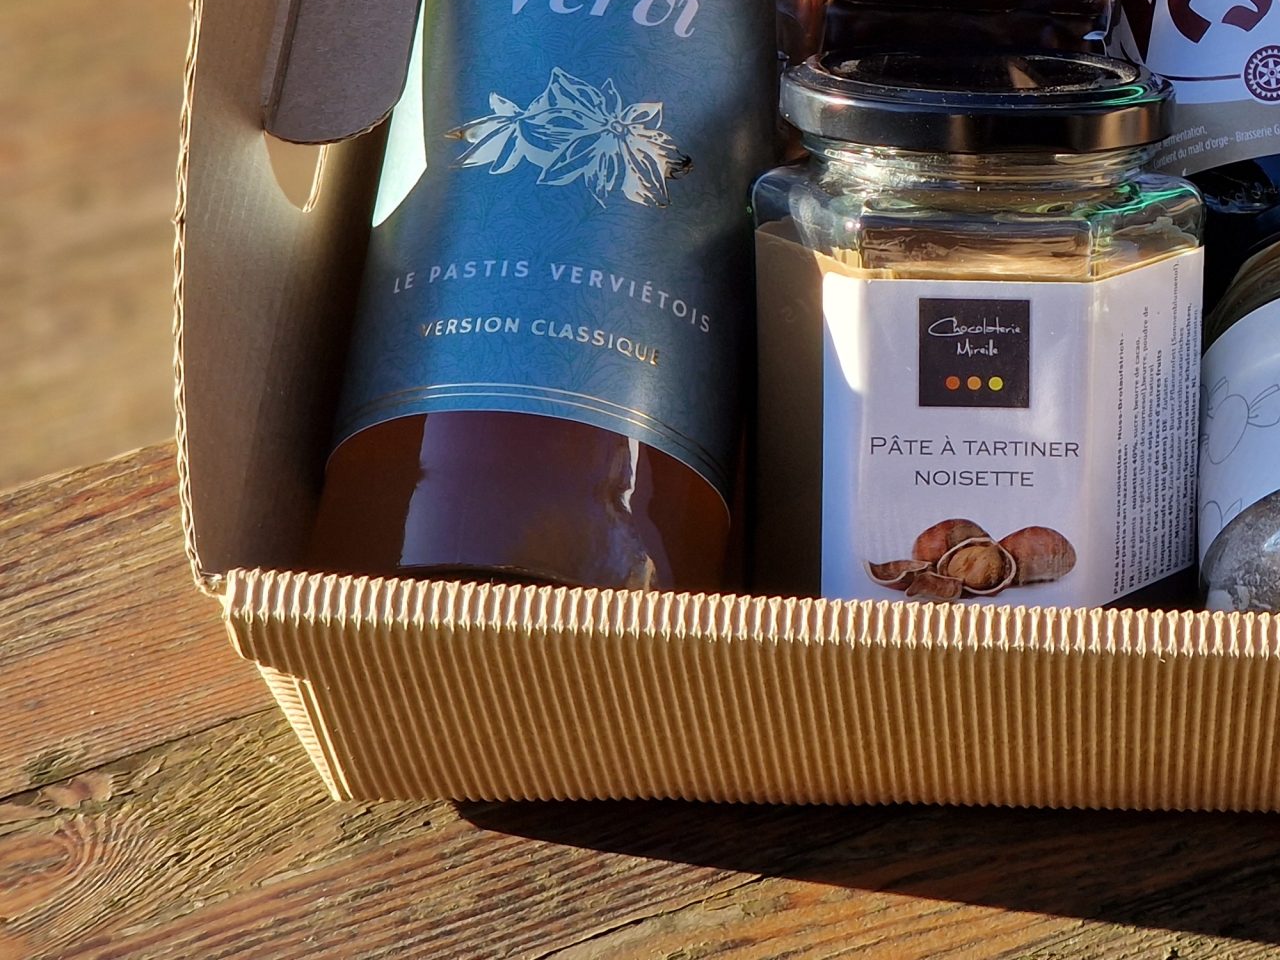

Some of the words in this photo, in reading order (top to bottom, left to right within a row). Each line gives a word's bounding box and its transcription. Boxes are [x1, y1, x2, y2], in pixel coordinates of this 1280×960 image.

[1188, 142, 1204, 155] malt
[1205, 136, 1229, 151] d'orge
[1235, 126, 1273, 143] Brasserie
[393, 271, 416, 295] LE
[428, 260, 530, 283] PASTIS
[550, 262, 711, 333] VERVIÉTOIS
[928, 316, 1021, 336] Chocolaterie
[421, 316, 520, 338] VERSION
[530, 319, 660, 367] CLASSIQUE
[870, 434, 934, 456] PÂTE
[940, 433, 956, 457] À
[963, 439, 1080, 459] TARTINER
[914, 470, 1035, 487] NOISETTE
